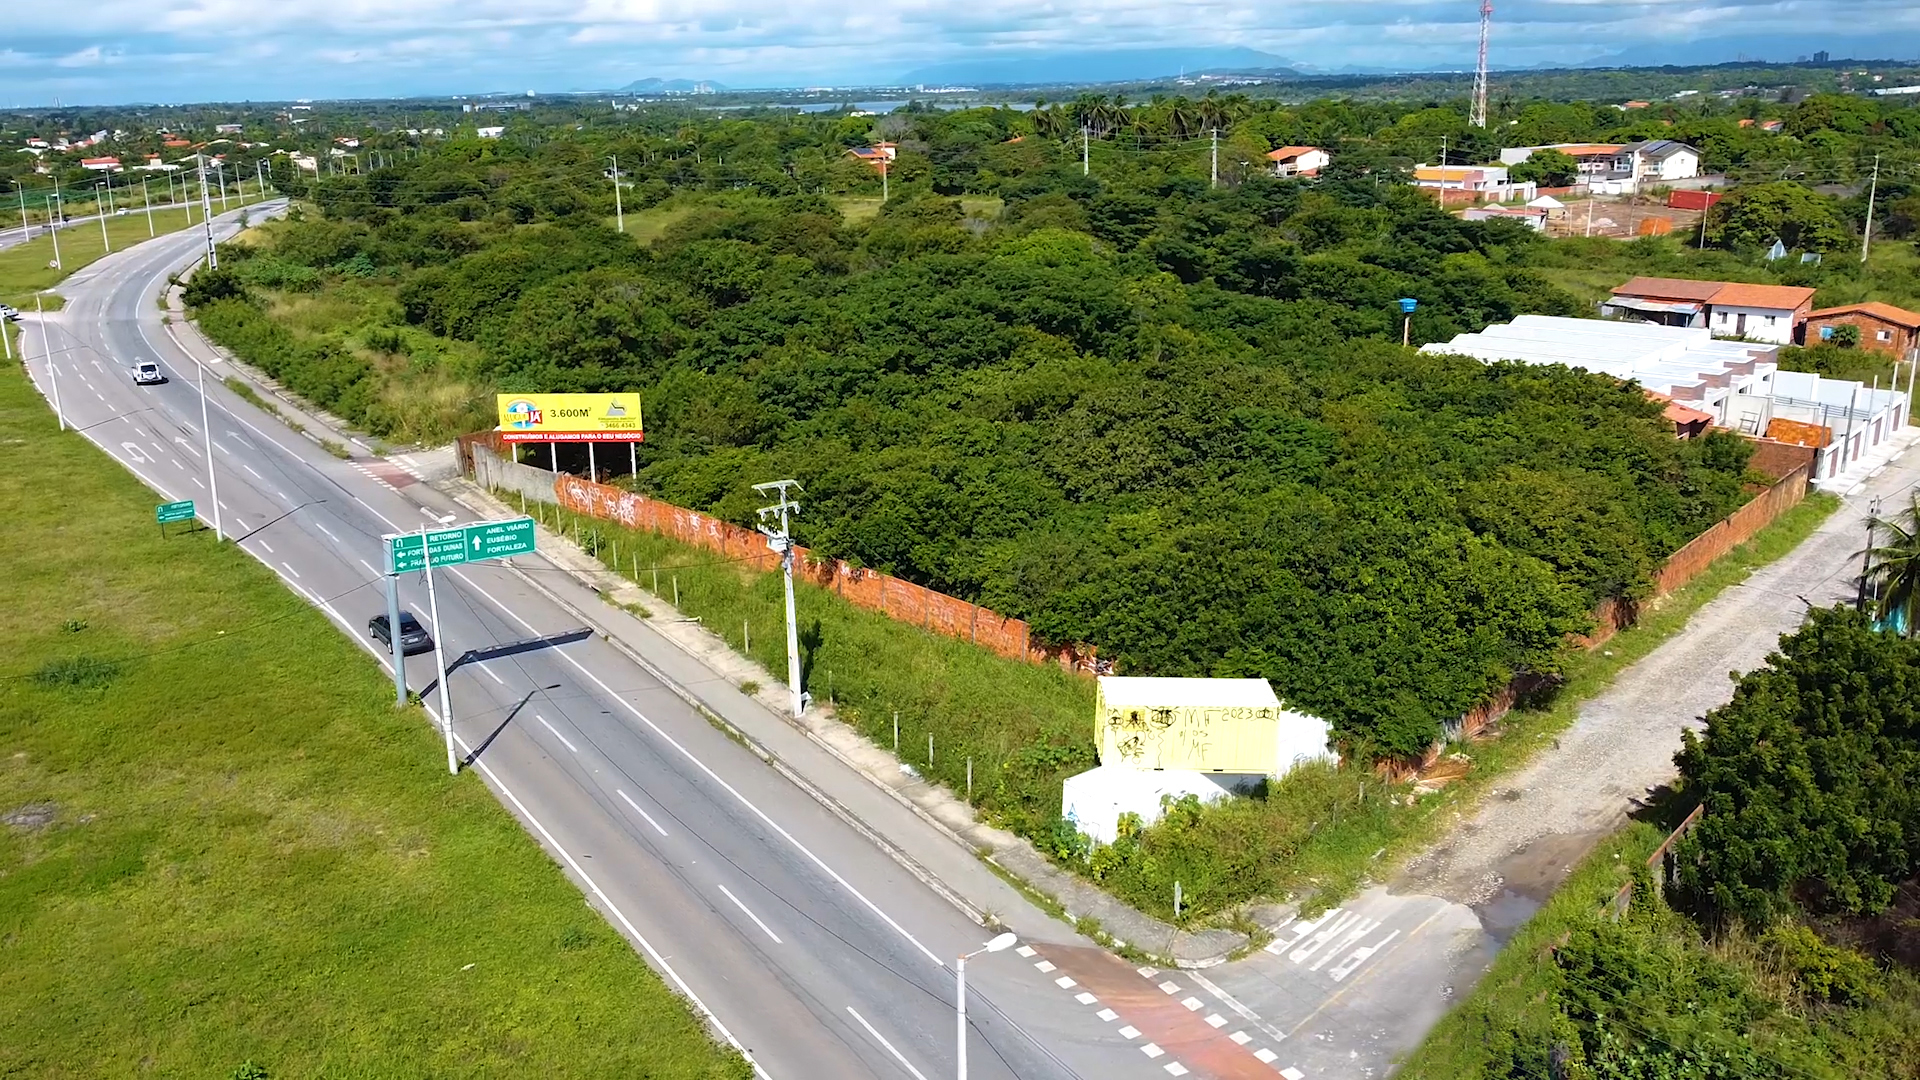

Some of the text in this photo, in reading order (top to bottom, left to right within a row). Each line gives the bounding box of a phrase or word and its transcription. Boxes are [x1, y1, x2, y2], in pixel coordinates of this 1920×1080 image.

[486, 522, 530, 534] ANEL VIÁRIO
[430, 531, 462, 542] RETORNO
[486, 534, 517, 544] EUSÉBIO
[429, 545, 442, 554] DAS
[443, 543, 463, 552] DUNAS
[487, 542, 527, 554] FORTALEZA
[440, 552, 464, 562] FUTURO
[1264, 908, 1400, 982] PARE
